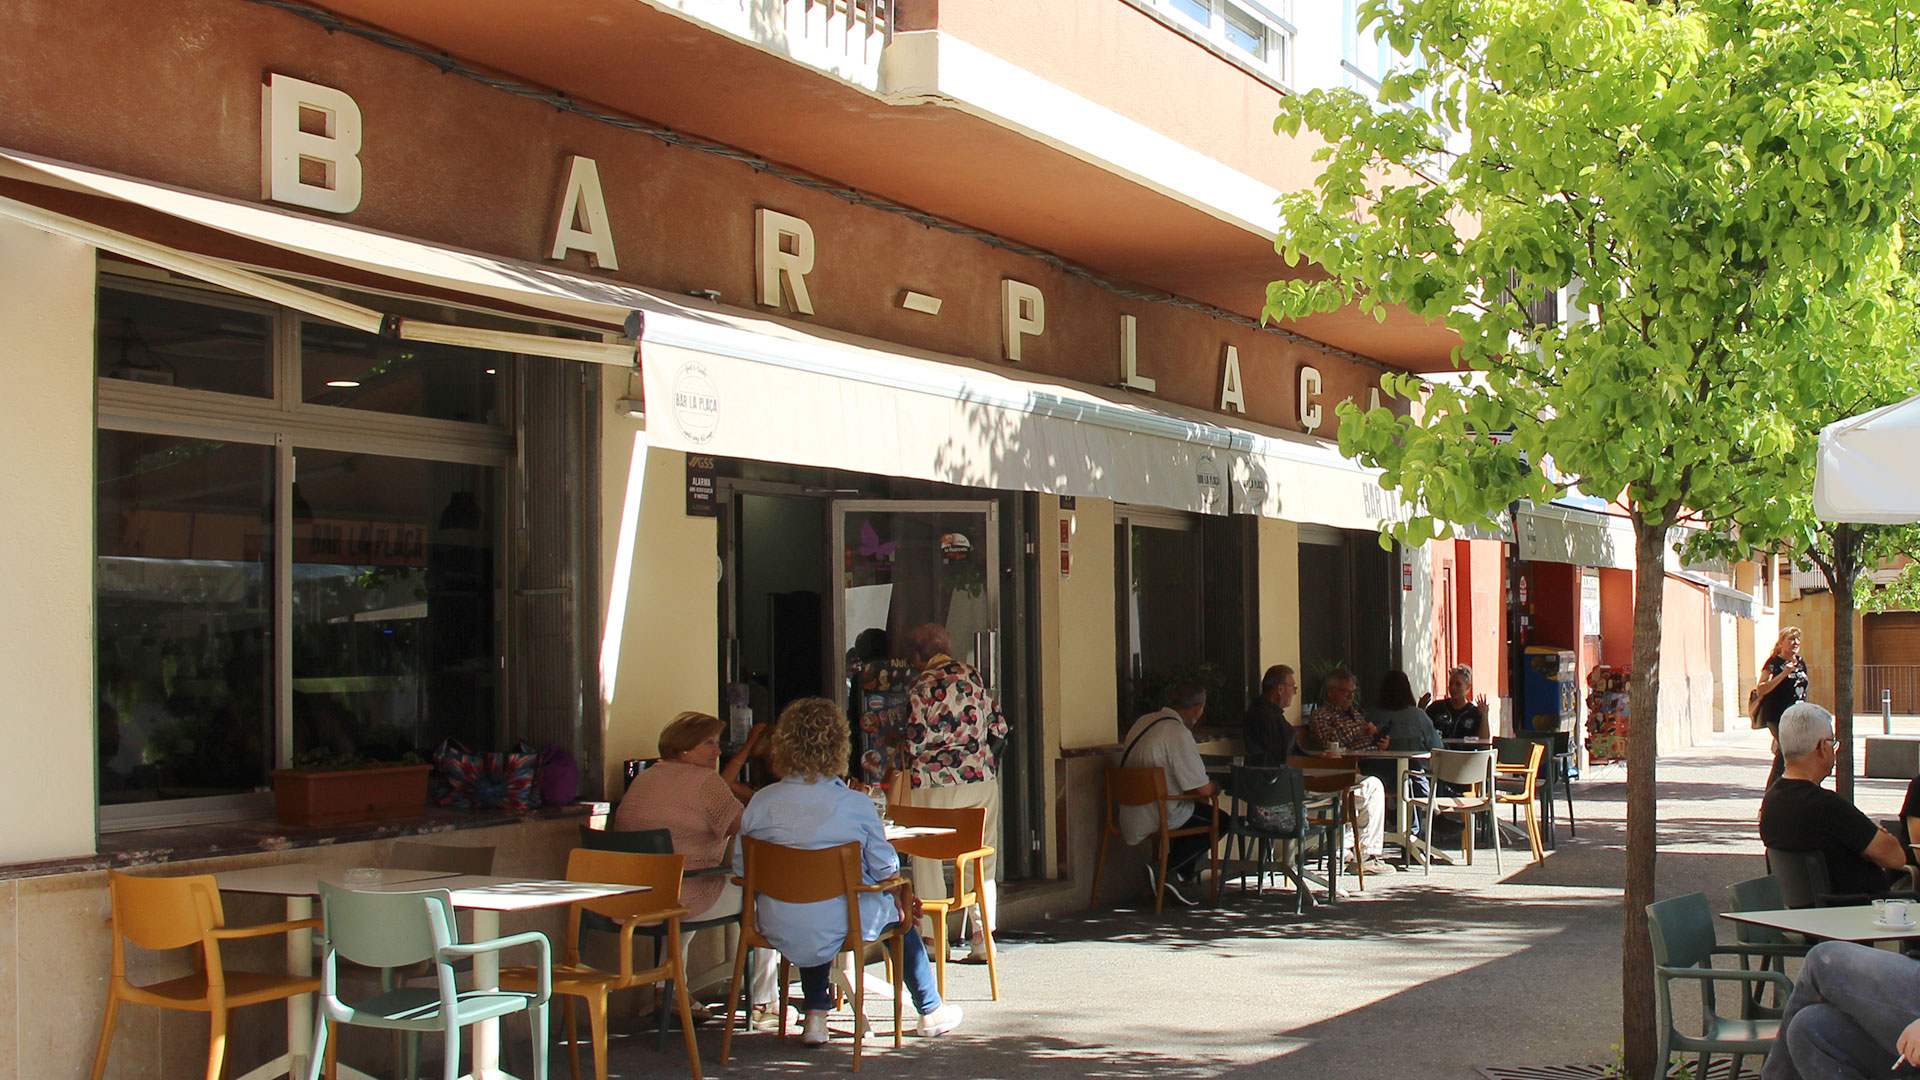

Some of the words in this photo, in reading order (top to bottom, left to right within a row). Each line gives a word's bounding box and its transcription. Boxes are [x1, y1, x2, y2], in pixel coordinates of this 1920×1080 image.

[676, 393, 687, 408] BAR
[689, 395, 697, 409] LA
[699, 397, 717, 413] PLAÇA
[692, 477, 711, 487] ALARMA
[1362, 482, 1381, 520] BAR
